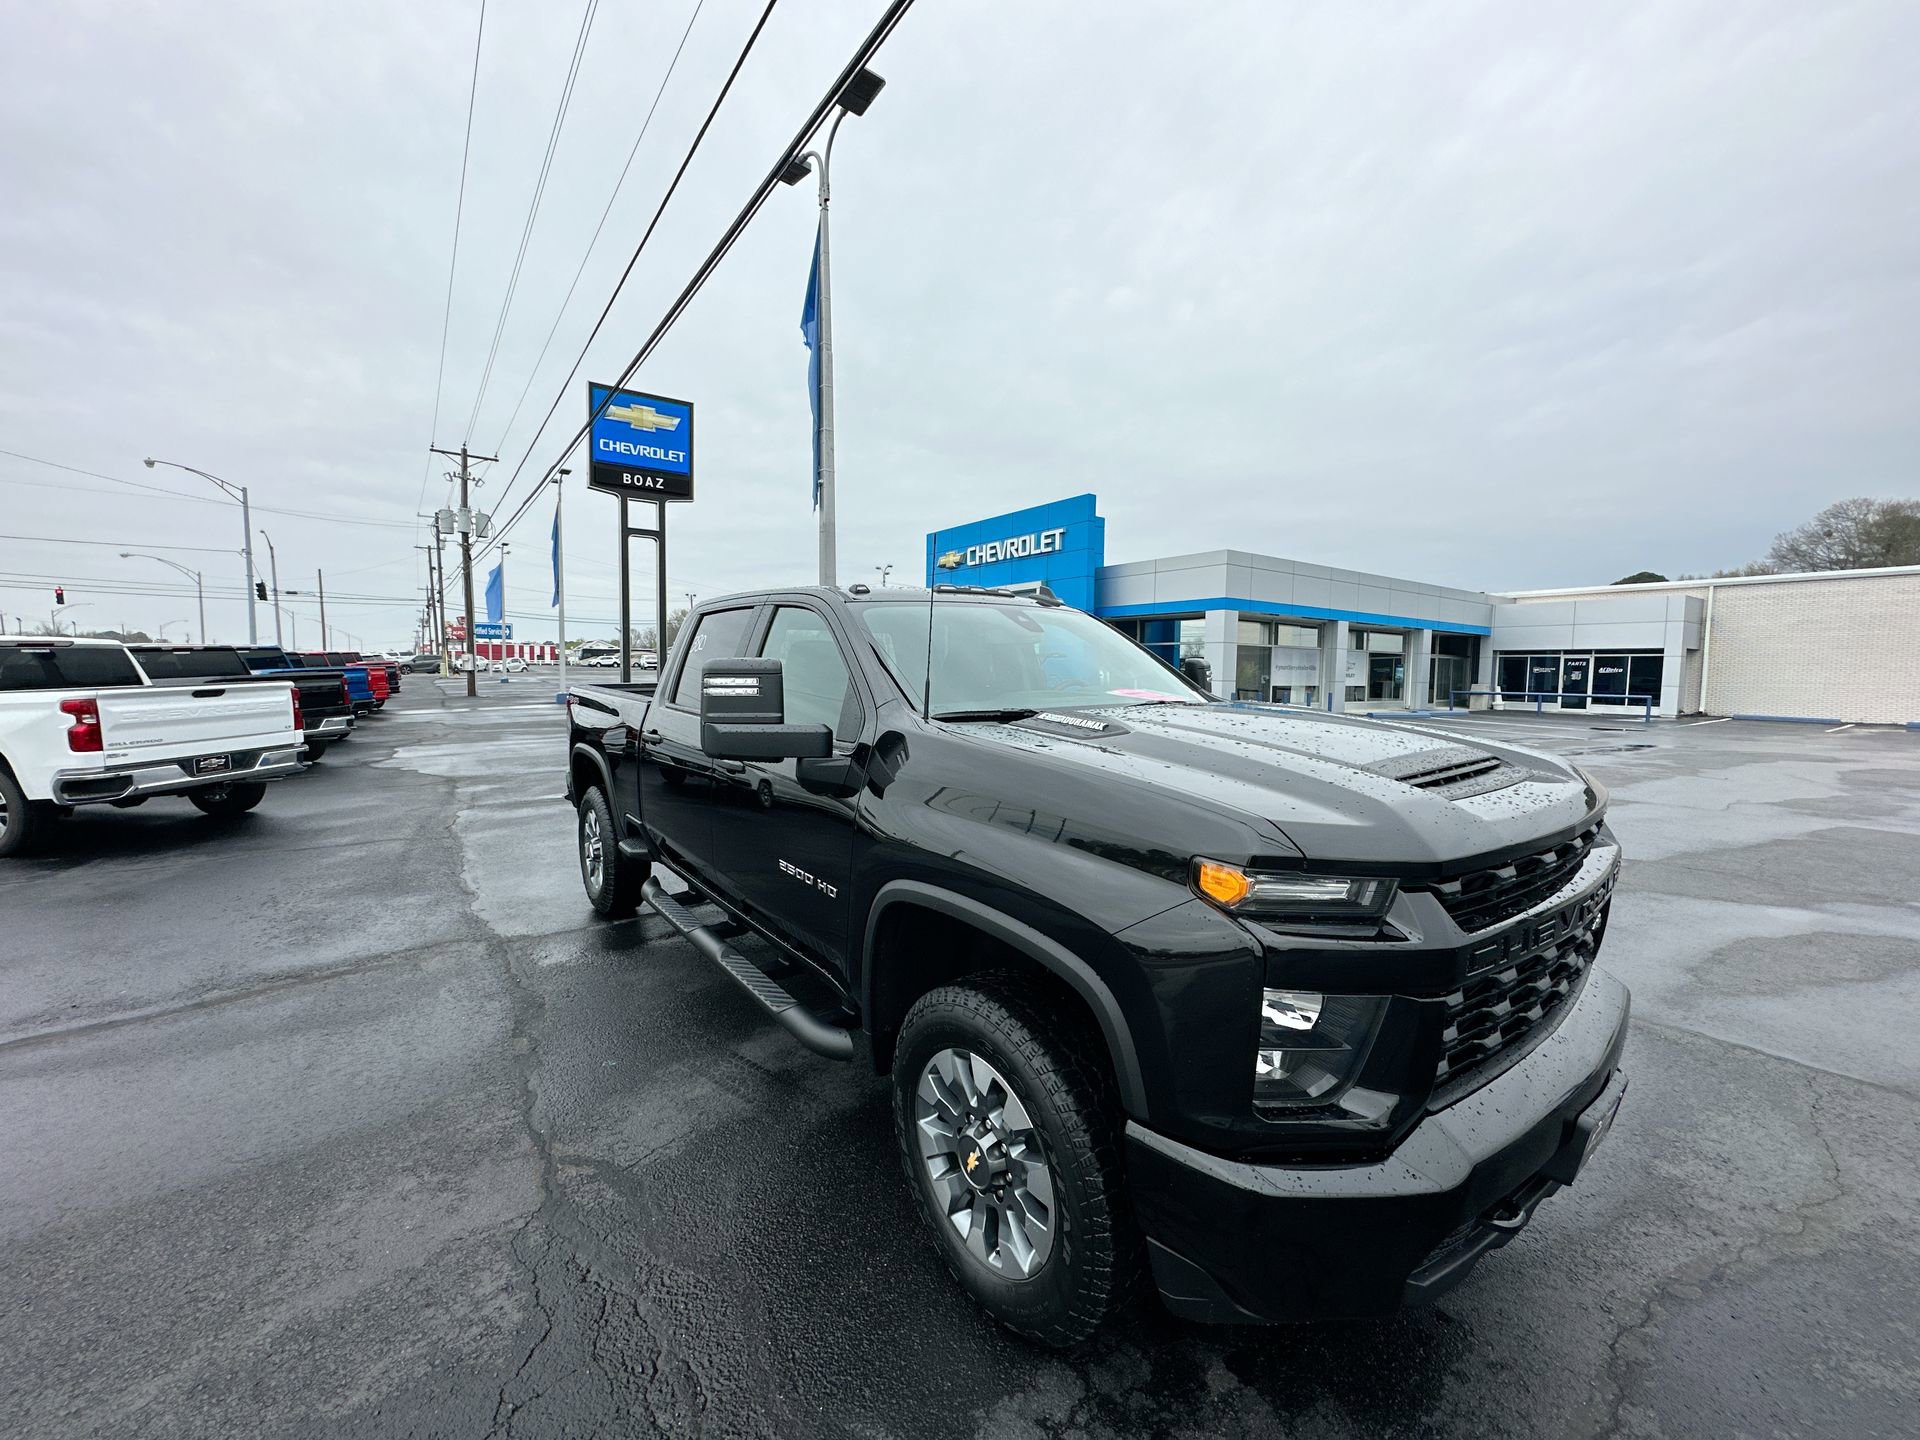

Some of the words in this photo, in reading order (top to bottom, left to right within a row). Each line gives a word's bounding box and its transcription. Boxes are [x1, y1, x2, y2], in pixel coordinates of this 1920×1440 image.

[599, 438, 686, 463] CHEVROLET
[622, 473, 665, 489] BOAZ
[966, 528, 1066, 566] CHEVROLET
[1061, 716, 1108, 731] DURAMAX
[778, 858, 814, 886] 2500
[816, 878, 838, 898] HD
